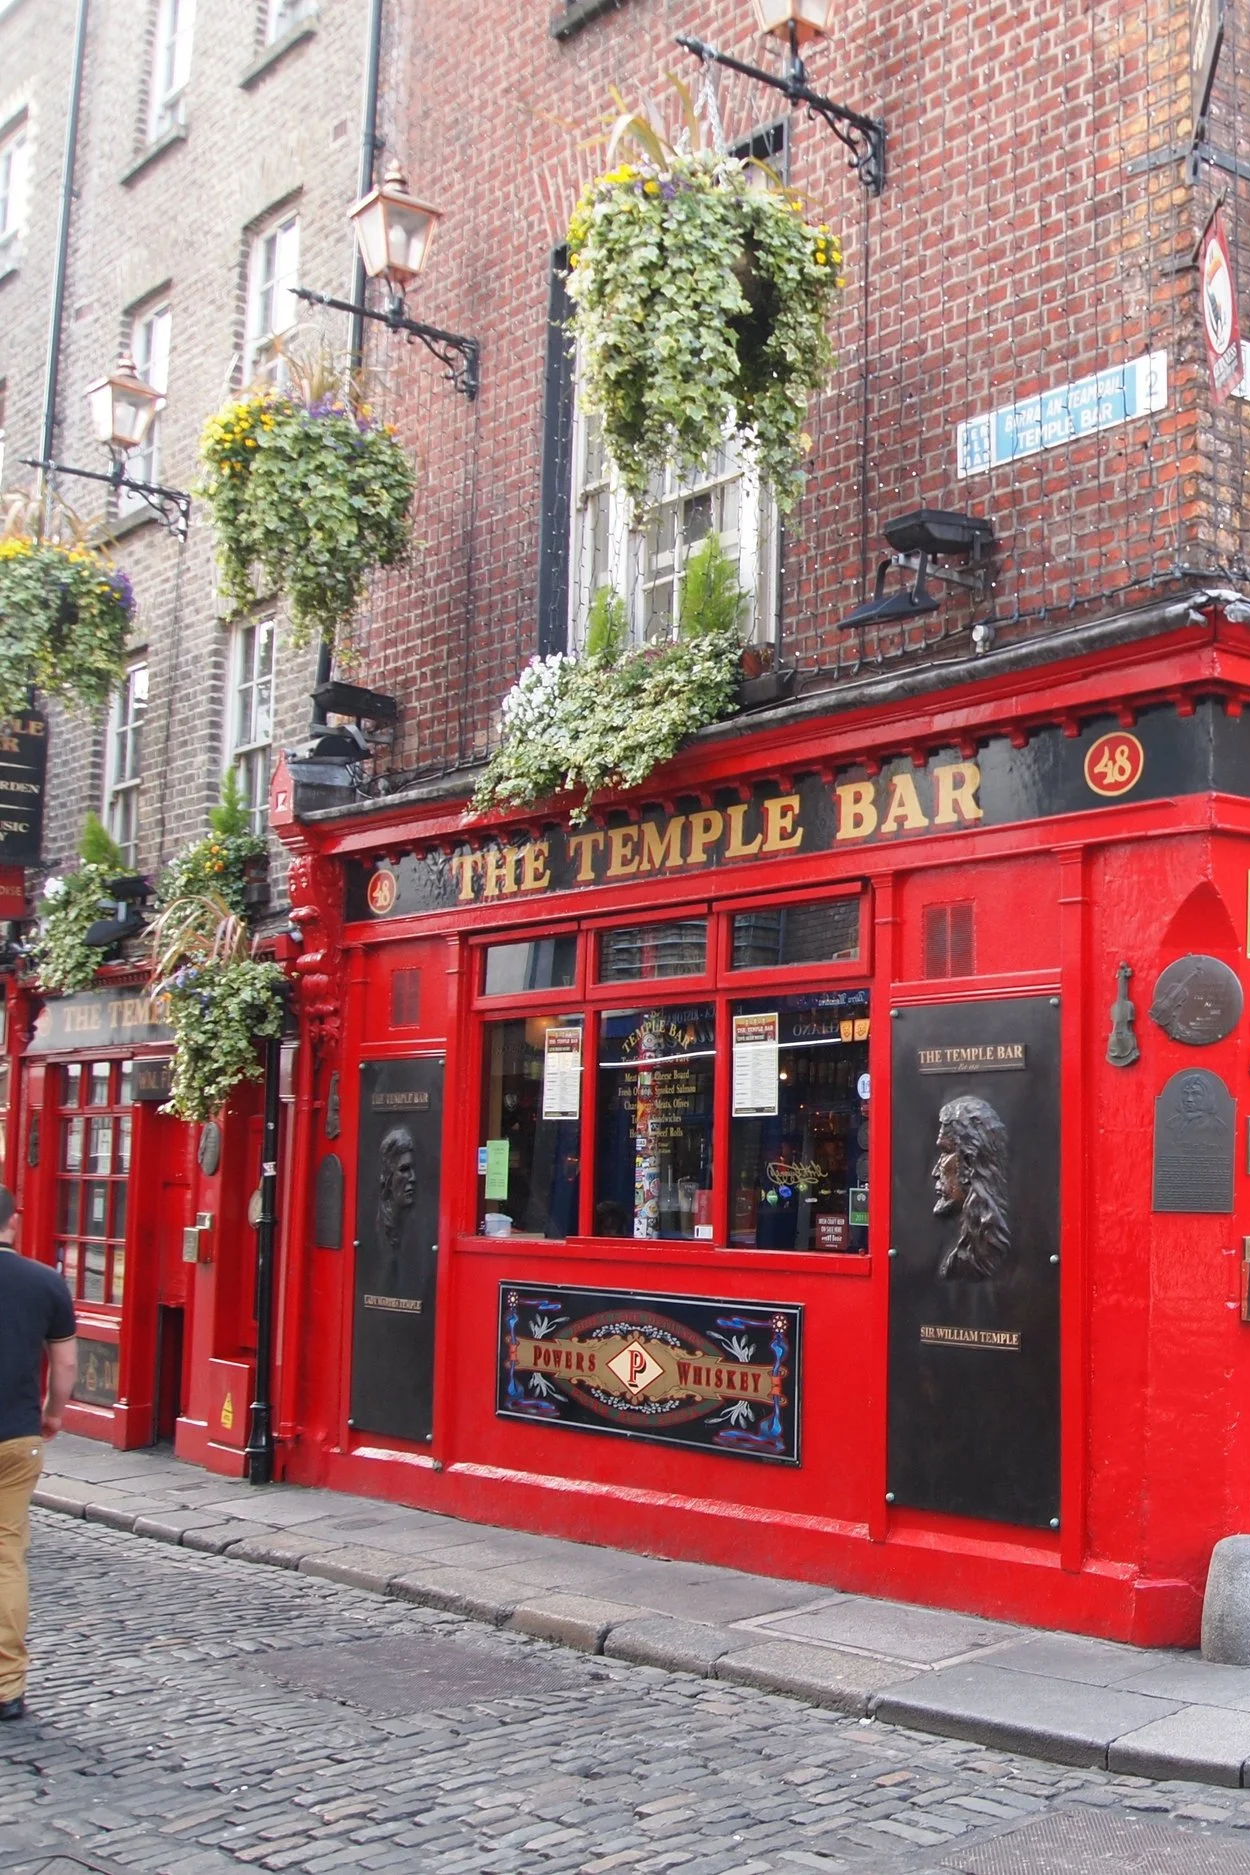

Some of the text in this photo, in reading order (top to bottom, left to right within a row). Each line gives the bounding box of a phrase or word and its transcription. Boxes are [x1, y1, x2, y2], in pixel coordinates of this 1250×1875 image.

[1144, 371, 1159, 399] 2
[1004, 405, 1041, 432] BARRA
[1046, 398, 1064, 416] AN
[1018, 403, 1113, 449] TEMPLE BAR
[1094, 745, 1132, 784] 48
[452, 762, 984, 901] THE TEMPLE BAR
[373, 882, 392, 908] 48
[64, 1004, 99, 1032] THE
[622, 1020, 690, 1053] TEMPLE BAR
[918, 1045, 1023, 1063] THE TEMPLE BAR
[920, 1326, 1019, 1346] SIR WILLIAM TEMPLE
[533, 1345, 762, 1393] POWERS P WHISKEY
